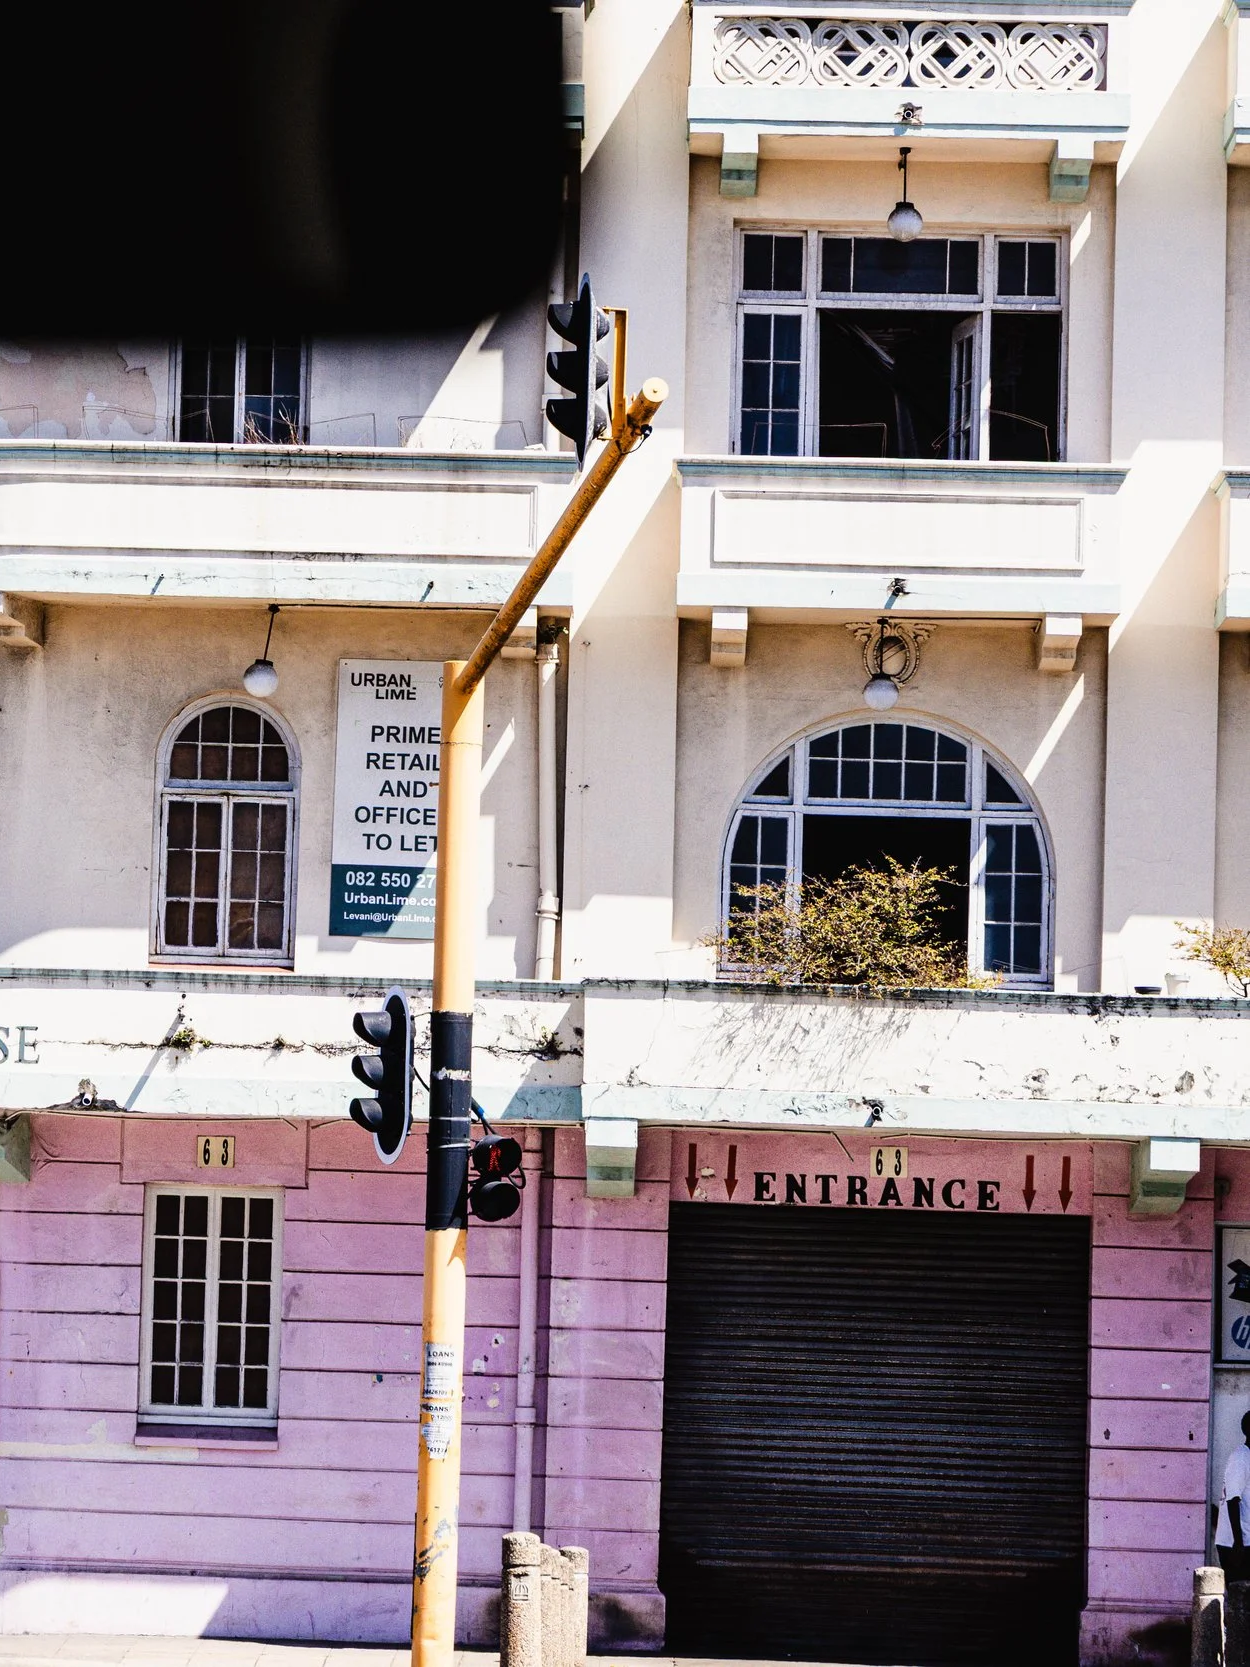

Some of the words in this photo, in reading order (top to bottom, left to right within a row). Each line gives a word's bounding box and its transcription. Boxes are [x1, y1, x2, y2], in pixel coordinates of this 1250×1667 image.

[351, 673, 412, 688] URBAN
[375, 685, 417, 700] LIME
[370, 725, 441, 744] PRIME
[366, 752, 440, 771] RETAIL
[379, 780, 428, 798] AND
[362, 833, 392, 851] TO
[400, 835, 438, 852] LET
[345, 871, 375, 886] 082
[381, 873, 411, 888] 550
[753, 1171, 1001, 1211] ENTRANCE
[427, 1350, 455, 1358] LOANS
